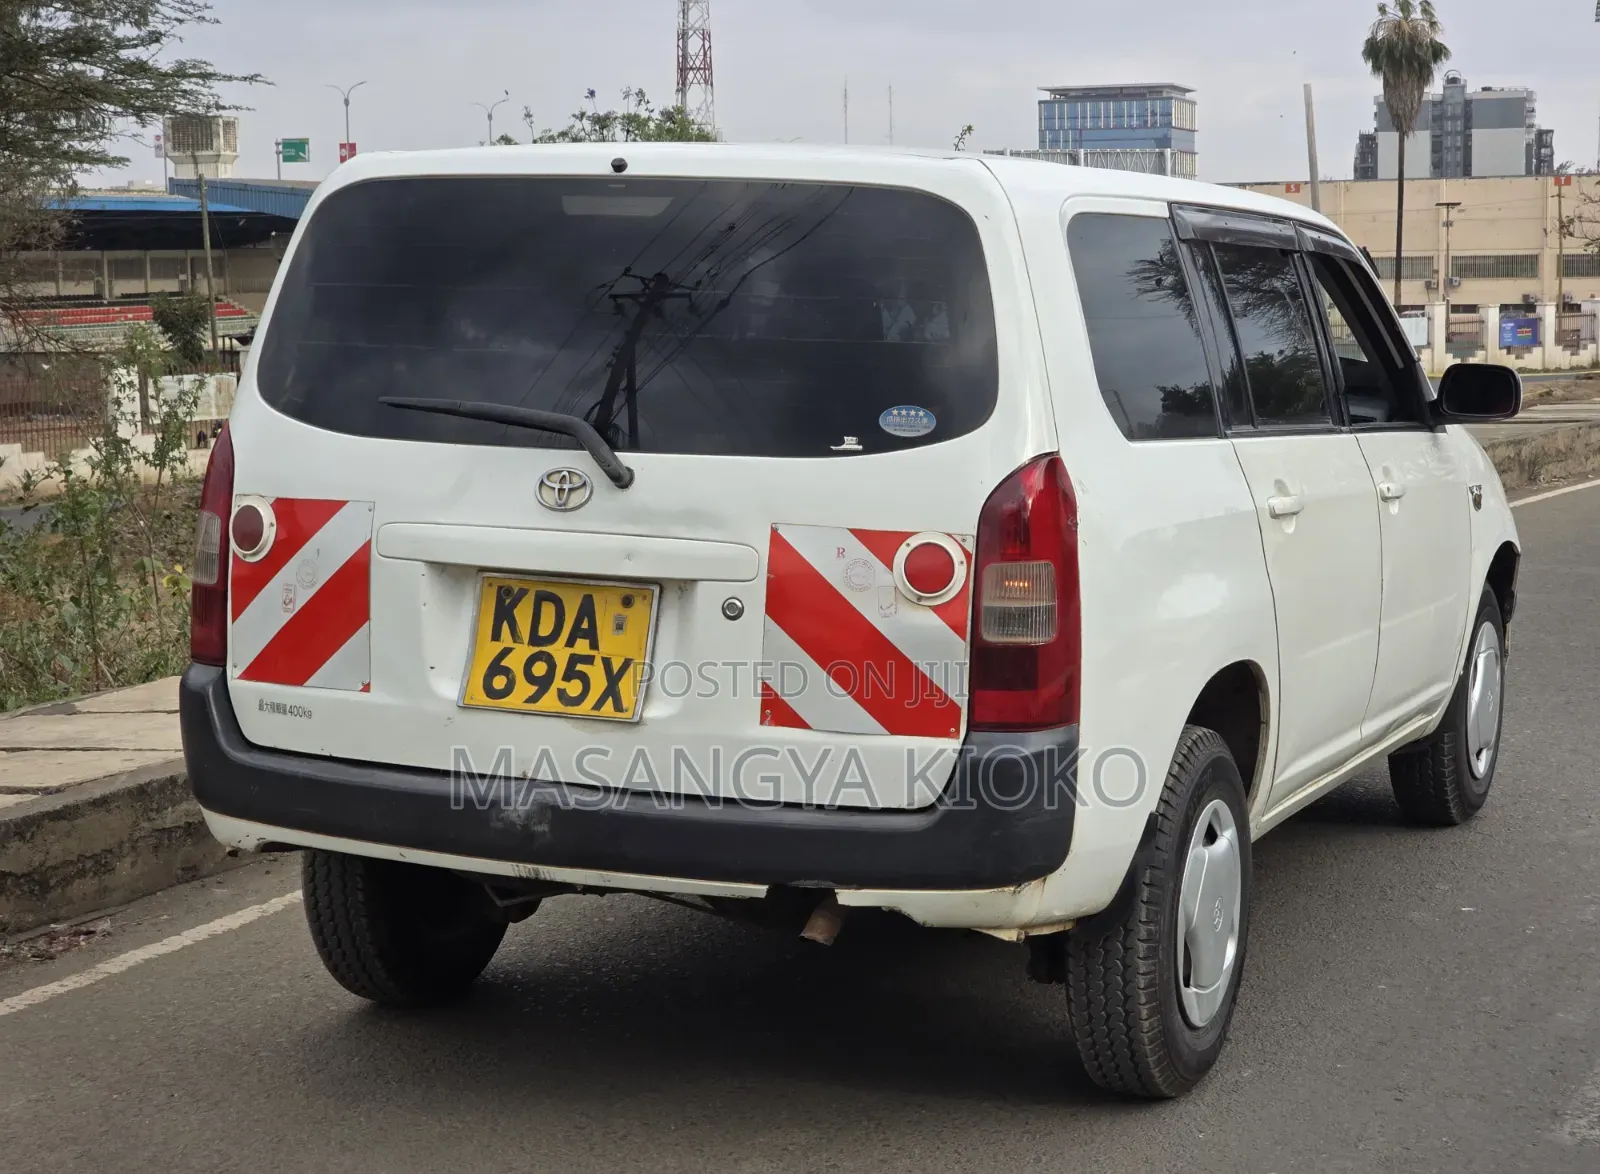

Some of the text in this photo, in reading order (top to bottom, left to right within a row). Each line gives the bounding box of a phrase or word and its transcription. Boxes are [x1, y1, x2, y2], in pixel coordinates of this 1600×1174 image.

[1290, 184, 1296, 192] S
[1560, 176, 1566, 185] T
[490, 585, 600, 652] KDA
[482, 647, 634, 713] 695X
